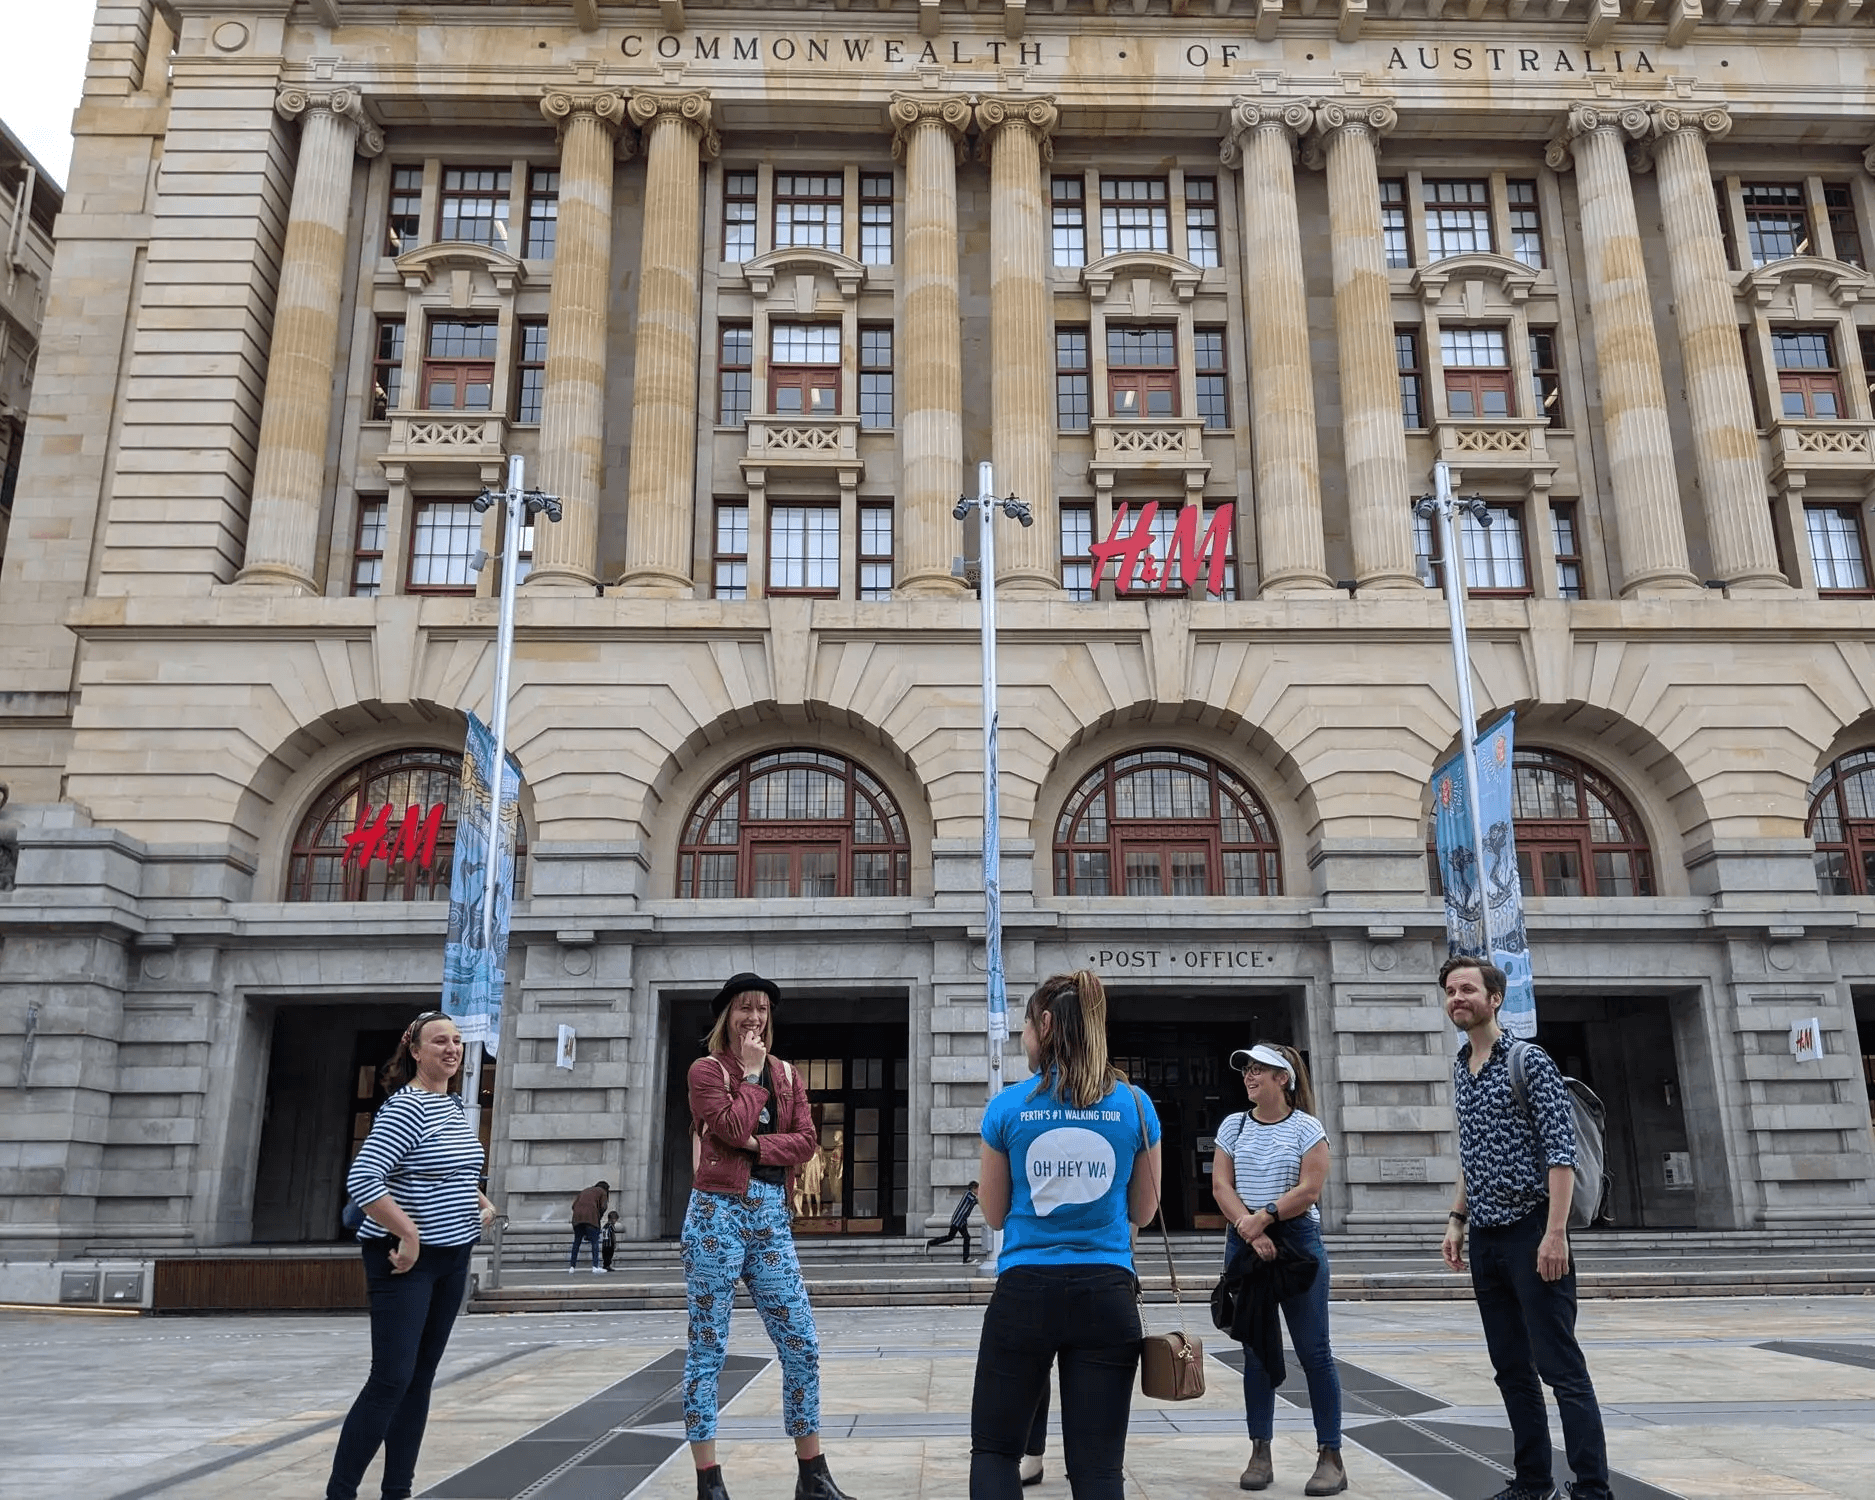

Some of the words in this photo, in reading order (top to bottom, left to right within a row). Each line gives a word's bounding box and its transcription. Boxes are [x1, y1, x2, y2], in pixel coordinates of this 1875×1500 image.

[621, 35, 1042, 66] COMMONWEALTH
[1186, 45, 1240, 67] OF
[1388, 47, 1655, 73] AUSTRALIA
[1088, 500, 1234, 597] H&M
[341, 802, 446, 871] H&M
[1100, 951, 1161, 968] POST
[1185, 951, 1264, 968] OFFICE
[1020, 1110, 1051, 1121] PERTH'S
[1052, 1110, 1062, 1120] #1
[1065, 1110, 1100, 1121] WALKING
[1101, 1110, 1121, 1122] TOUR
[1033, 1160, 1052, 1177] OH
[1057, 1160, 1083, 1178] HEY
[1088, 1161, 1107, 1178] WA
